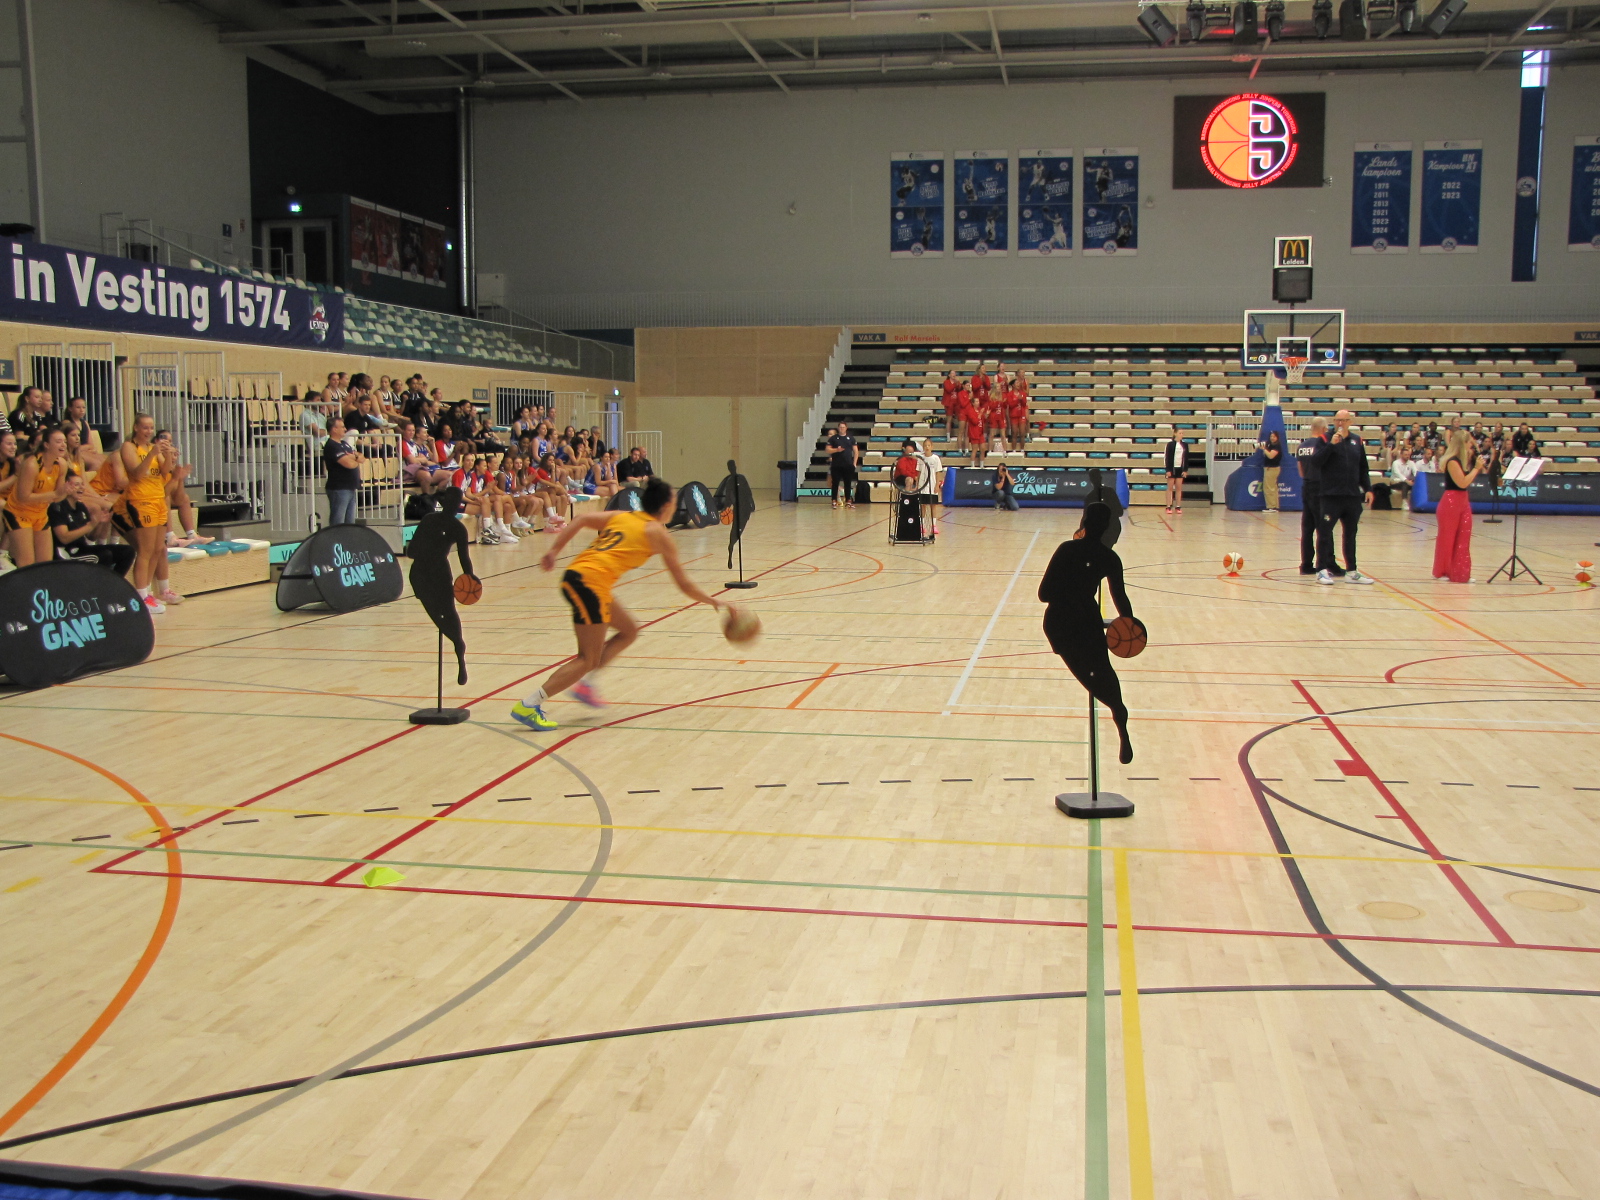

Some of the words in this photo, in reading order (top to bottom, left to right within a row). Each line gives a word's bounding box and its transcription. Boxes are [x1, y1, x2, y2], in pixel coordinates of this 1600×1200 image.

[1368, 156, 1398, 168] Lands
[1427, 160, 1464, 172] Kampioen
[1361, 166, 1402, 179] kampioen
[1441, 192, 1460, 200] 2023
[12, 243, 56, 303] in
[66, 253, 210, 332] Vesting
[220, 279, 291, 331] 1574
[1013, 472, 1036, 484] She
[1013, 484, 1057, 496] GAME
[333, 543, 354, 568] She
[353, 551, 372, 564] GOT
[340, 562, 376, 587] GAME
[31, 588, 68, 624] She
[68, 597, 100, 616] GOT
[42, 613, 107, 651] GAME
